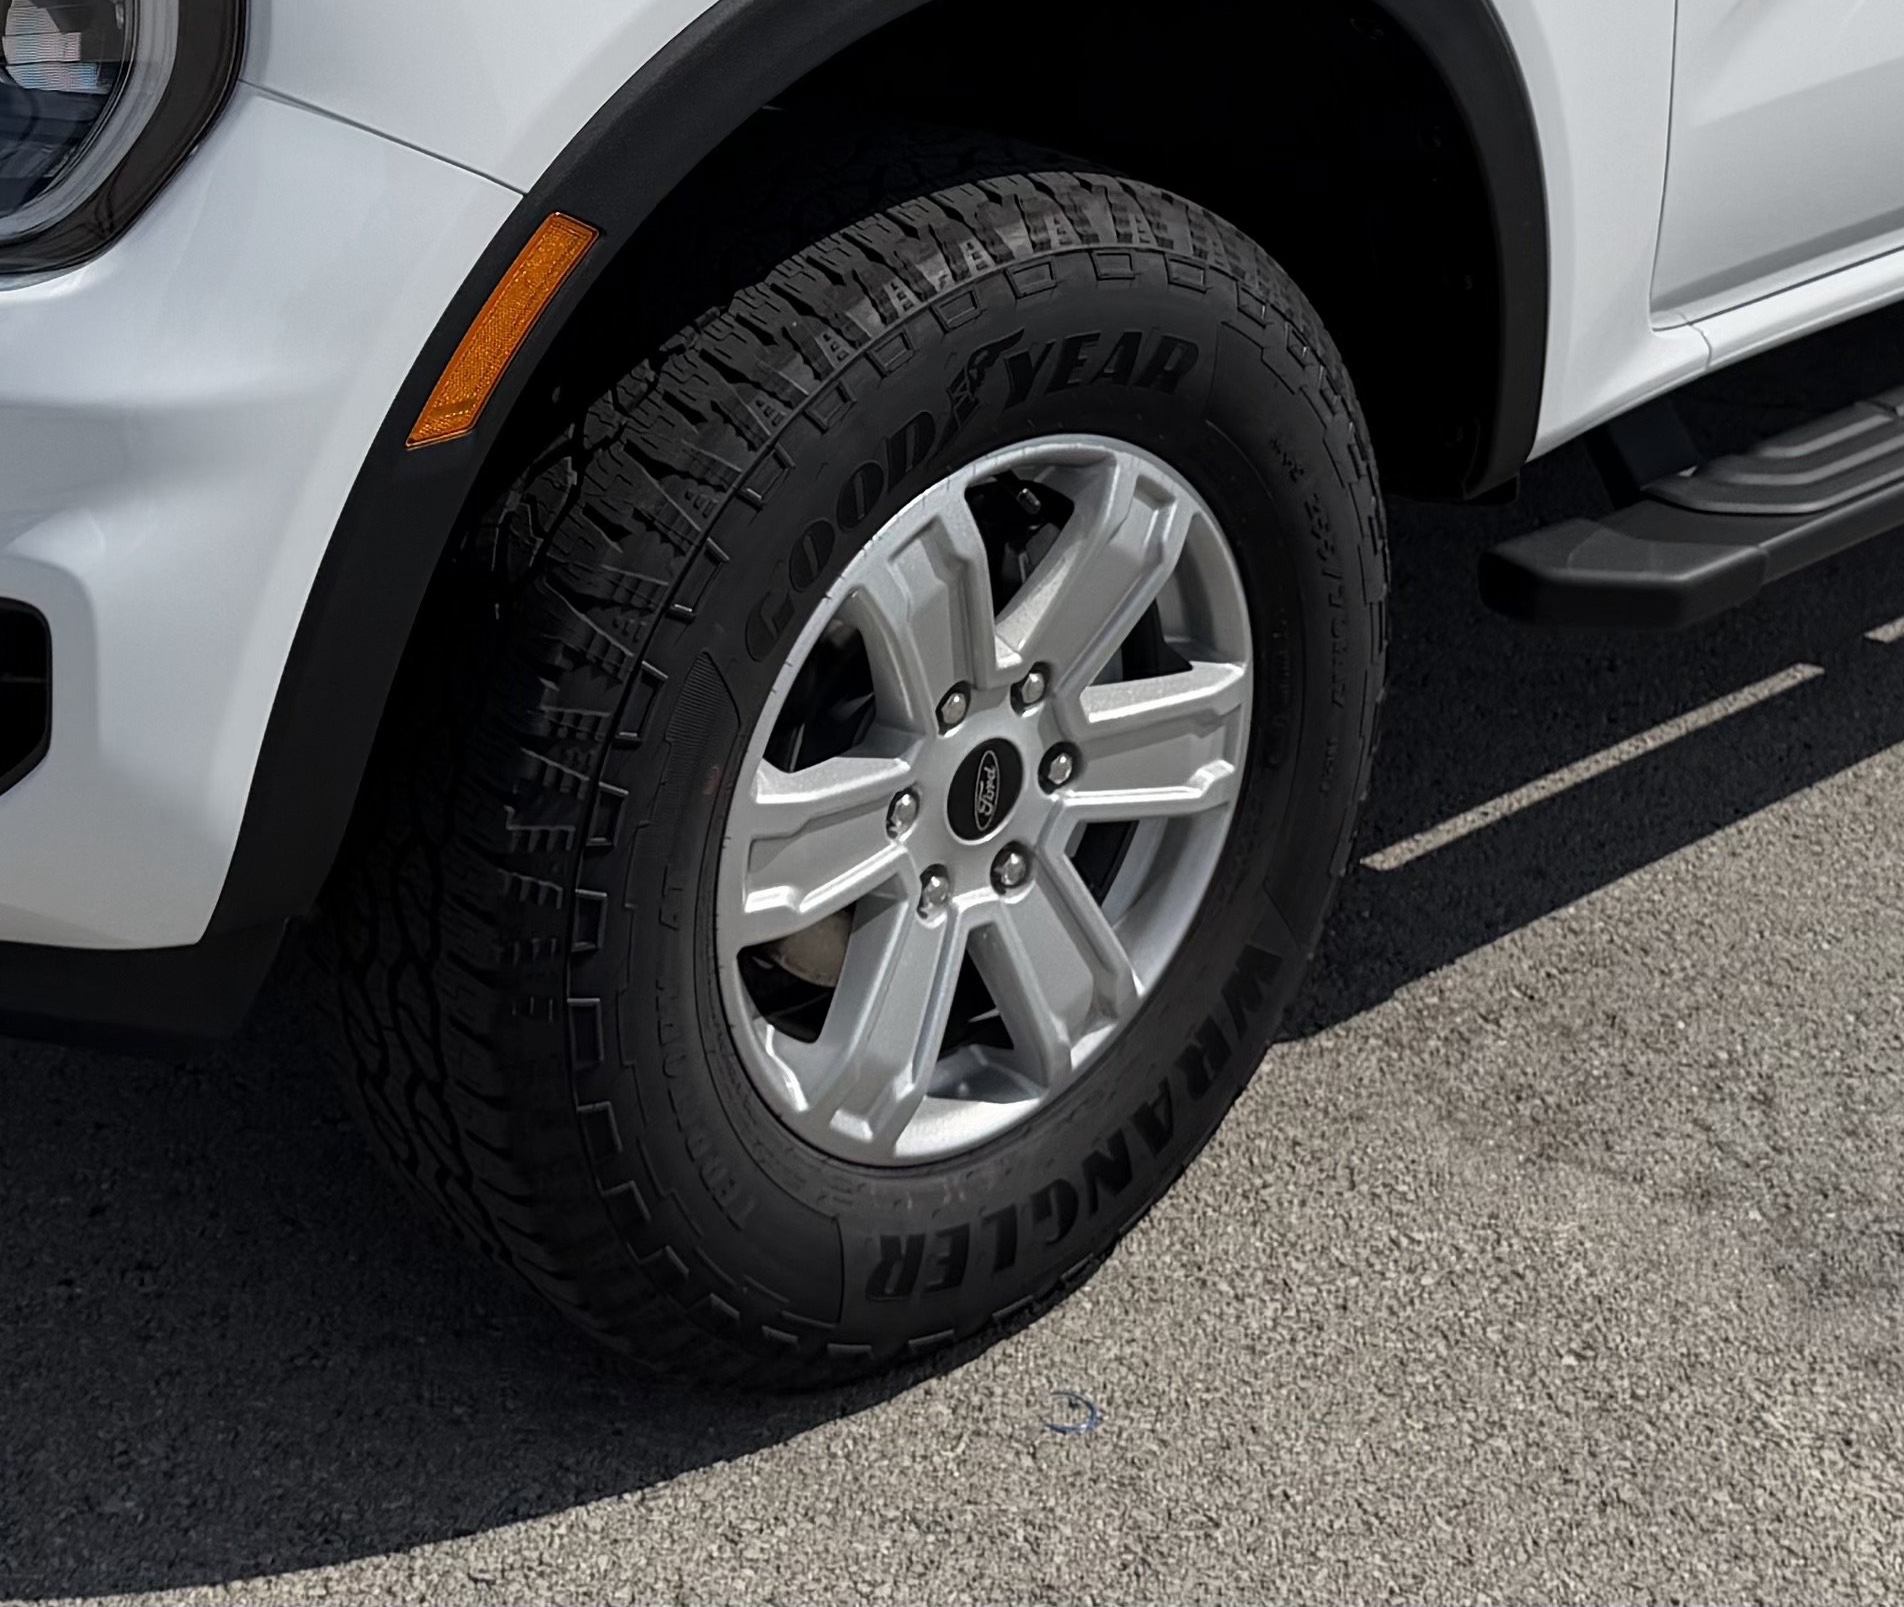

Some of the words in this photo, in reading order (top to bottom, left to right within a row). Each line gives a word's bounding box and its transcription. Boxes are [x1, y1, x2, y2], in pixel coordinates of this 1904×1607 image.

[745, 329, 1200, 662] GOODYEAR
[978, 766, 996, 816] Ford
[863, 943, 1282, 1302] WRANGLER
